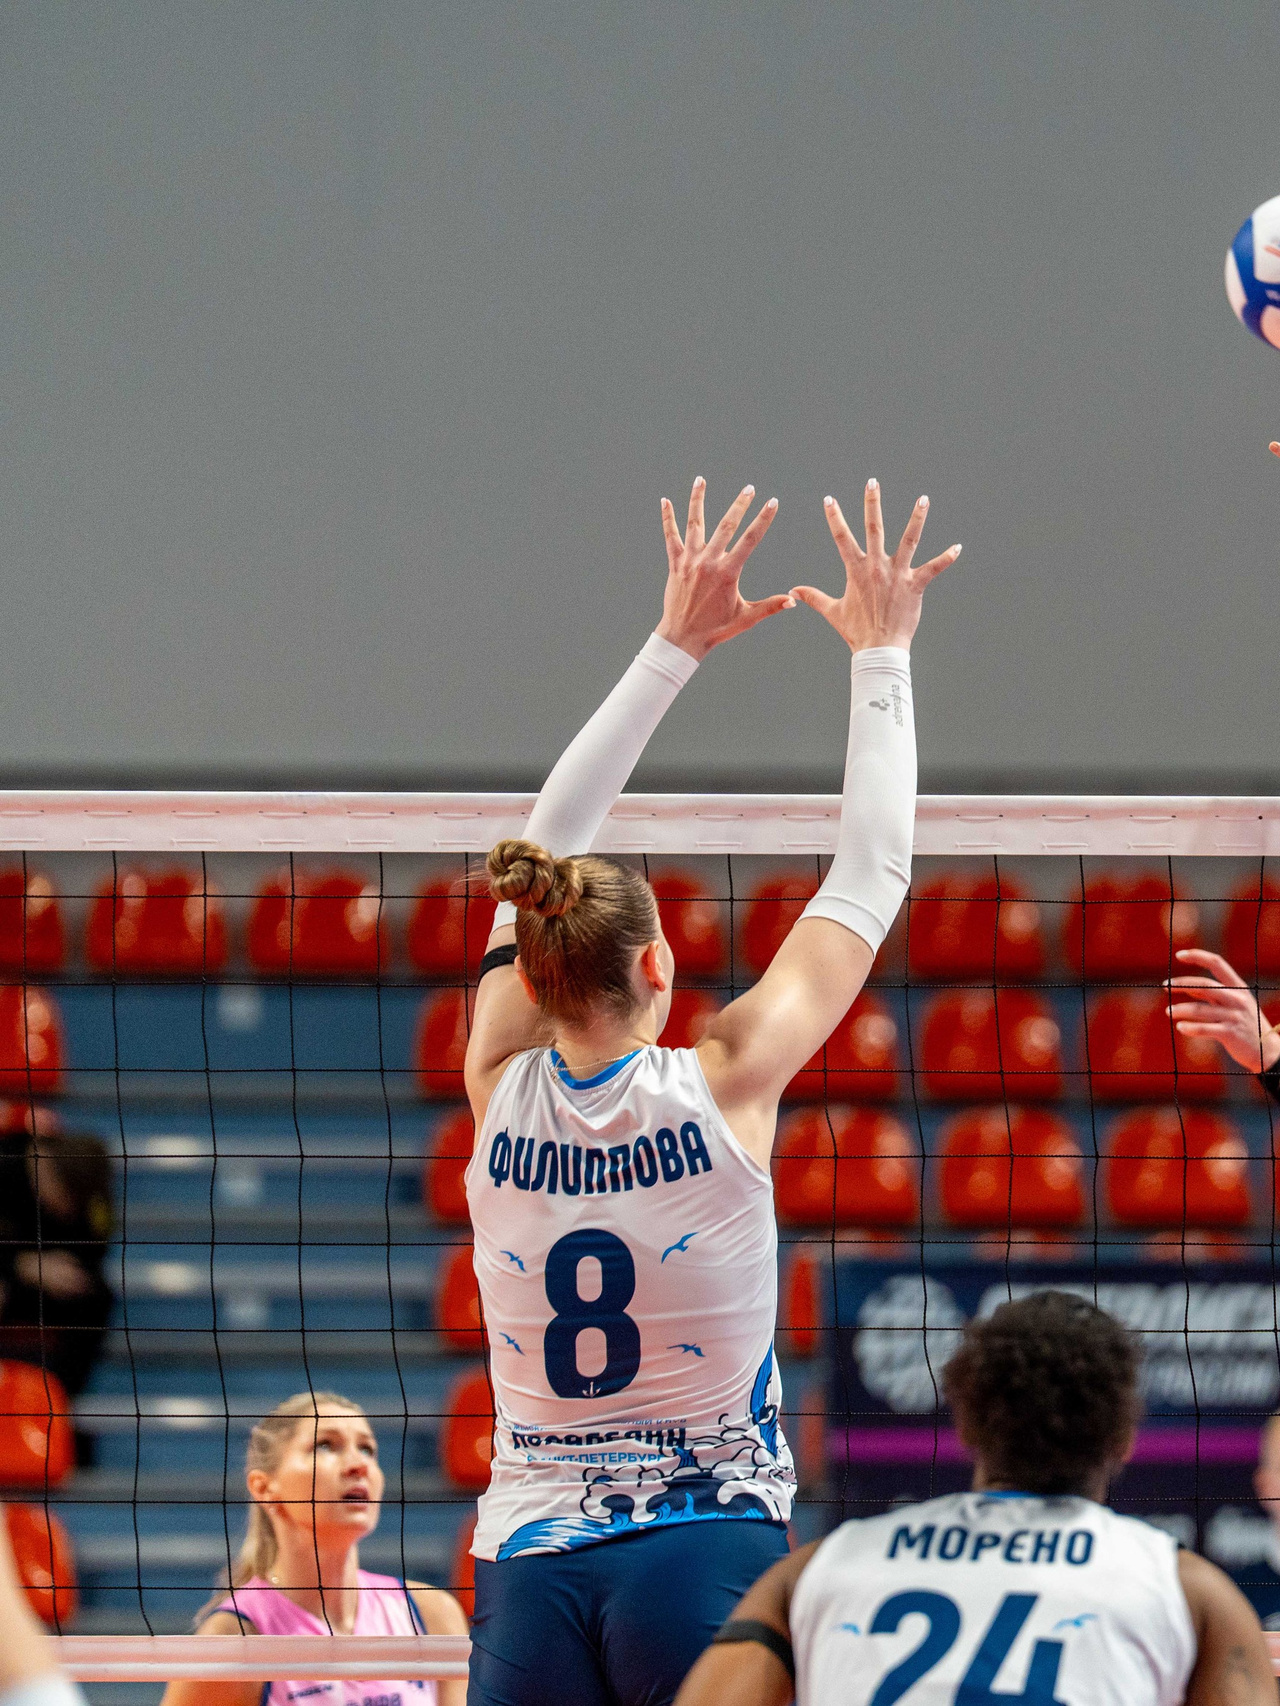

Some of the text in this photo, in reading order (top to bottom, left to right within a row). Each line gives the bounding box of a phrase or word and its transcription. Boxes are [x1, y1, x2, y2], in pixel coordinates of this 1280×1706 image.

[488, 1121, 712, 1196] ФИЛИППОВА
[543, 1228, 641, 1399] 8
[887, 1524, 1094, 1565] МОРЕНО
[868, 1588, 1070, 1706] 24
